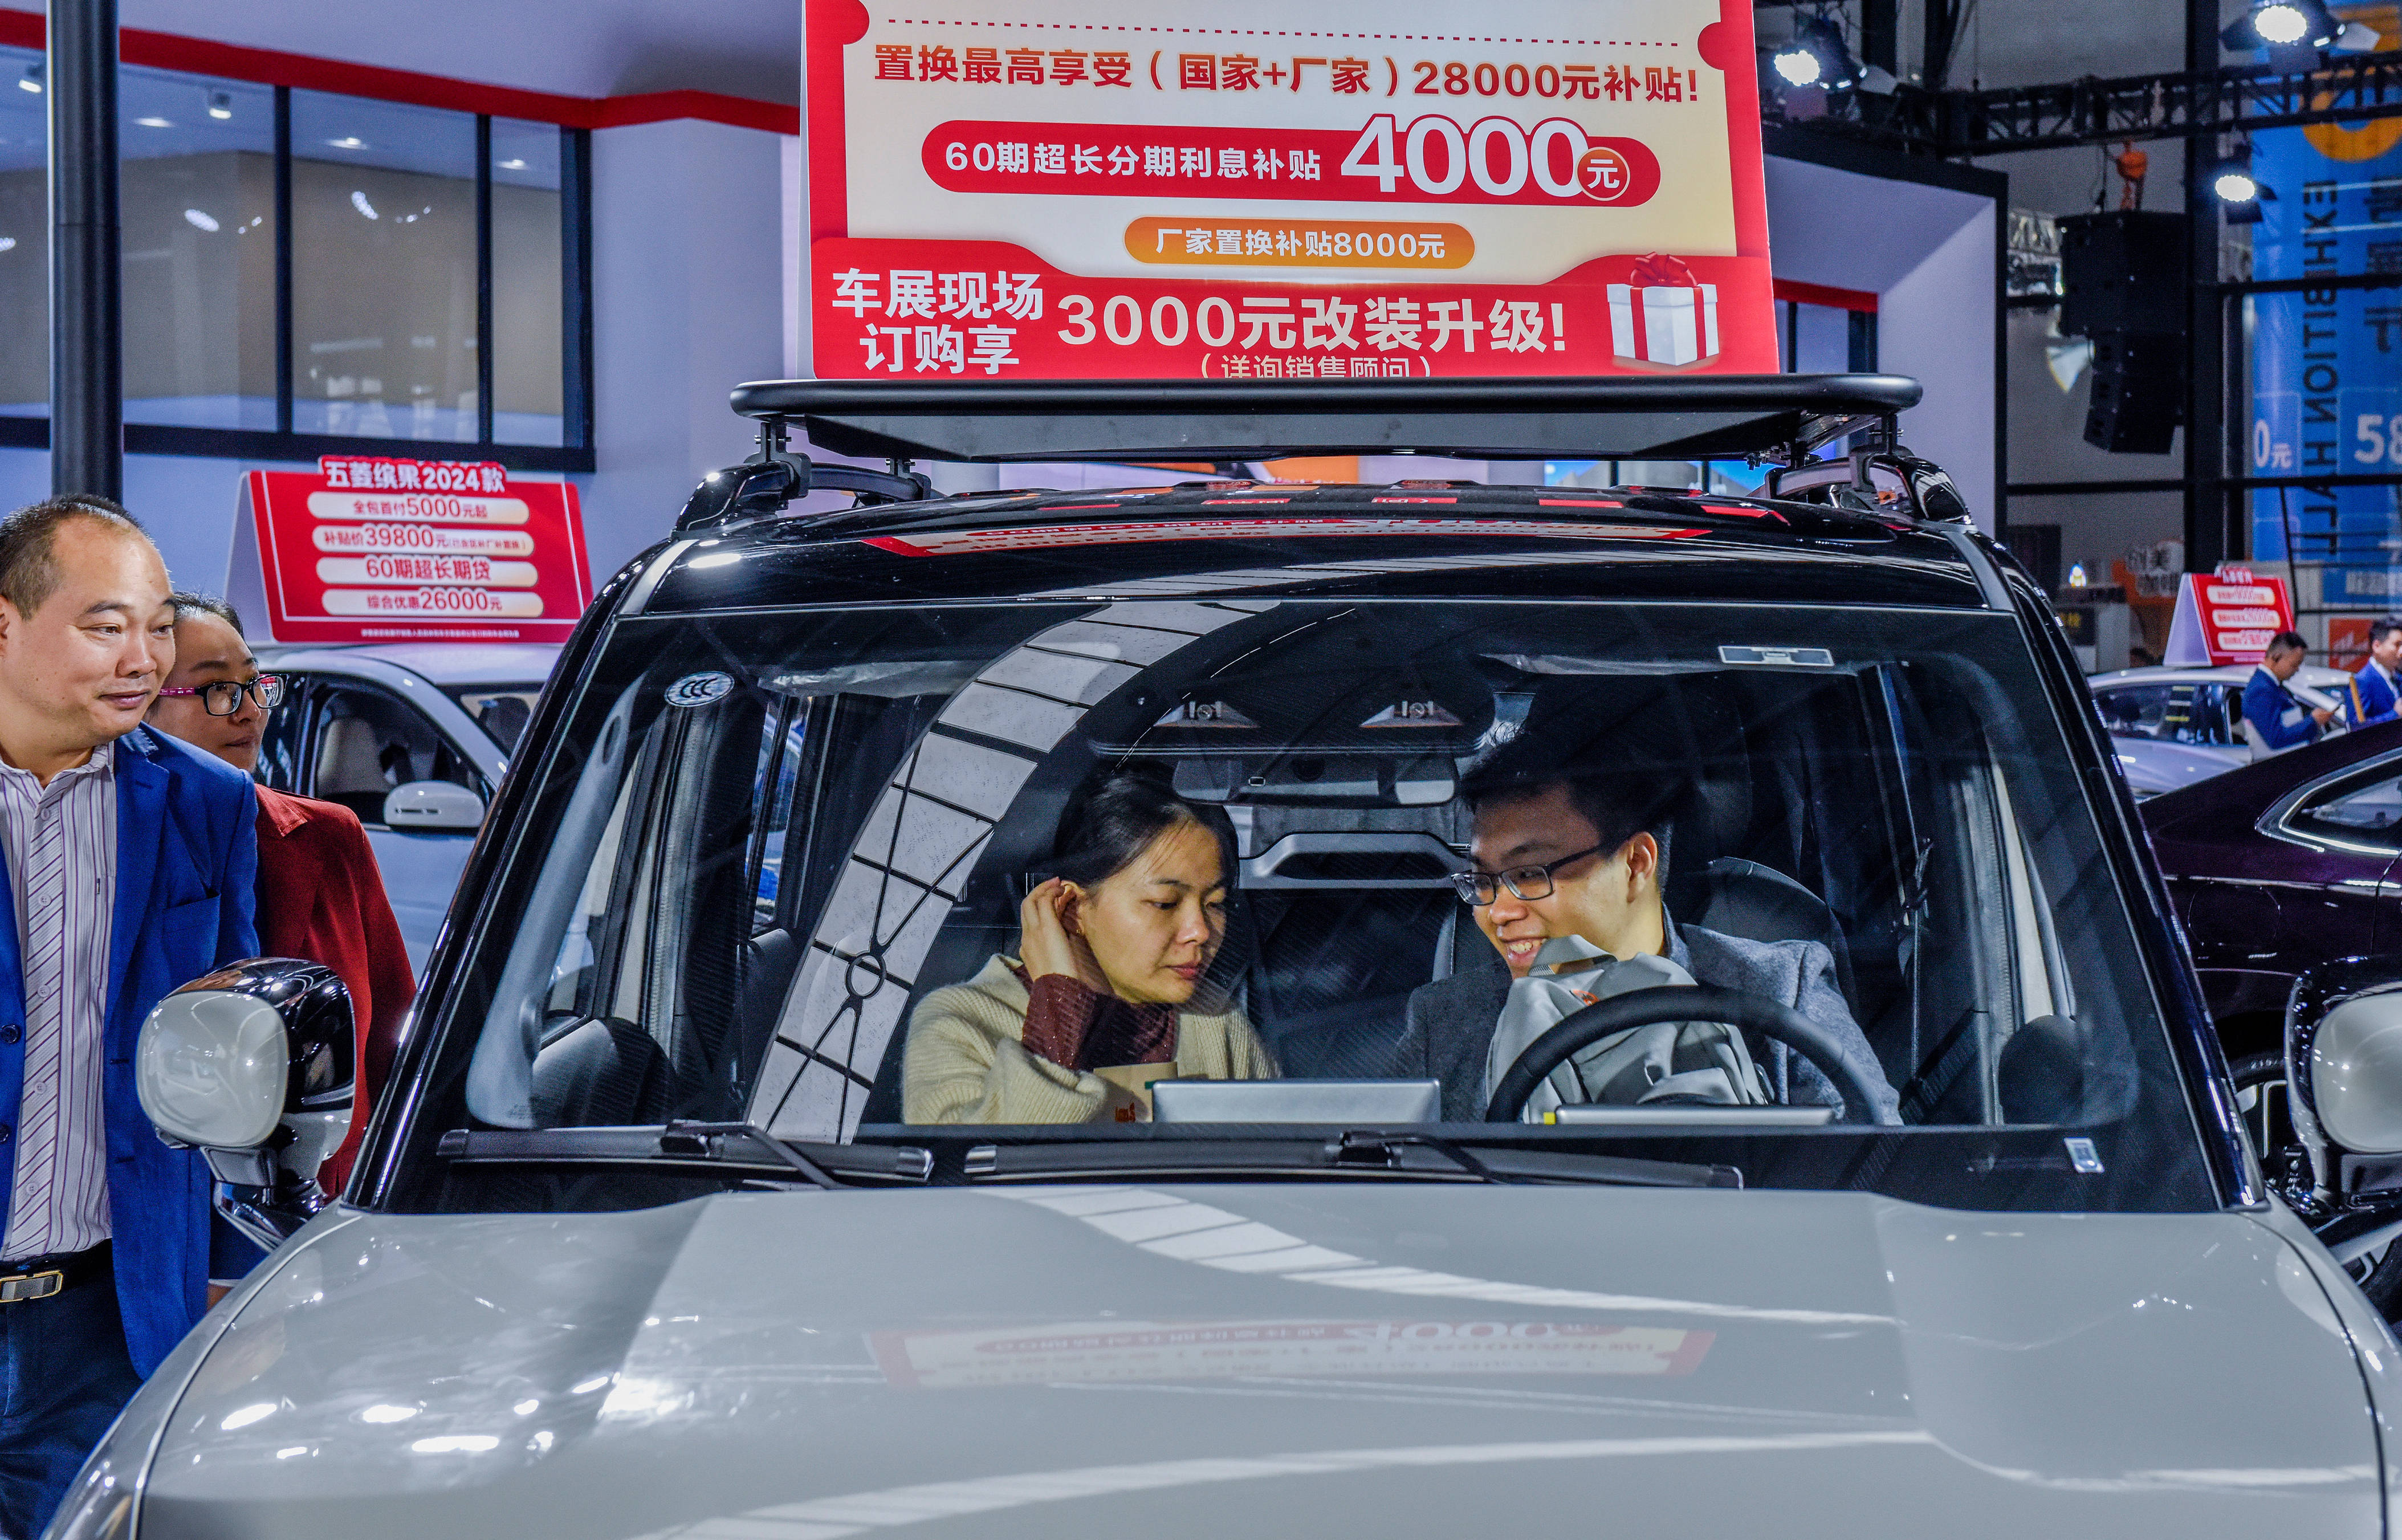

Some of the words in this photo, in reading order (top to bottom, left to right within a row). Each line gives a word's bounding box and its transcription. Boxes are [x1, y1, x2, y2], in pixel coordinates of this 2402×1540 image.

[945, 141, 1321, 182] 60期超长分期利息补贴
[1155, 228, 1446, 259] 厂家置换补贴8000元
[832, 268, 1044, 320] 车展现场
[860, 323, 1019, 374] 订购享
[367, 559, 491, 580] 60期超长期贷
[367, 591, 502, 611] 综合优惠26000元
